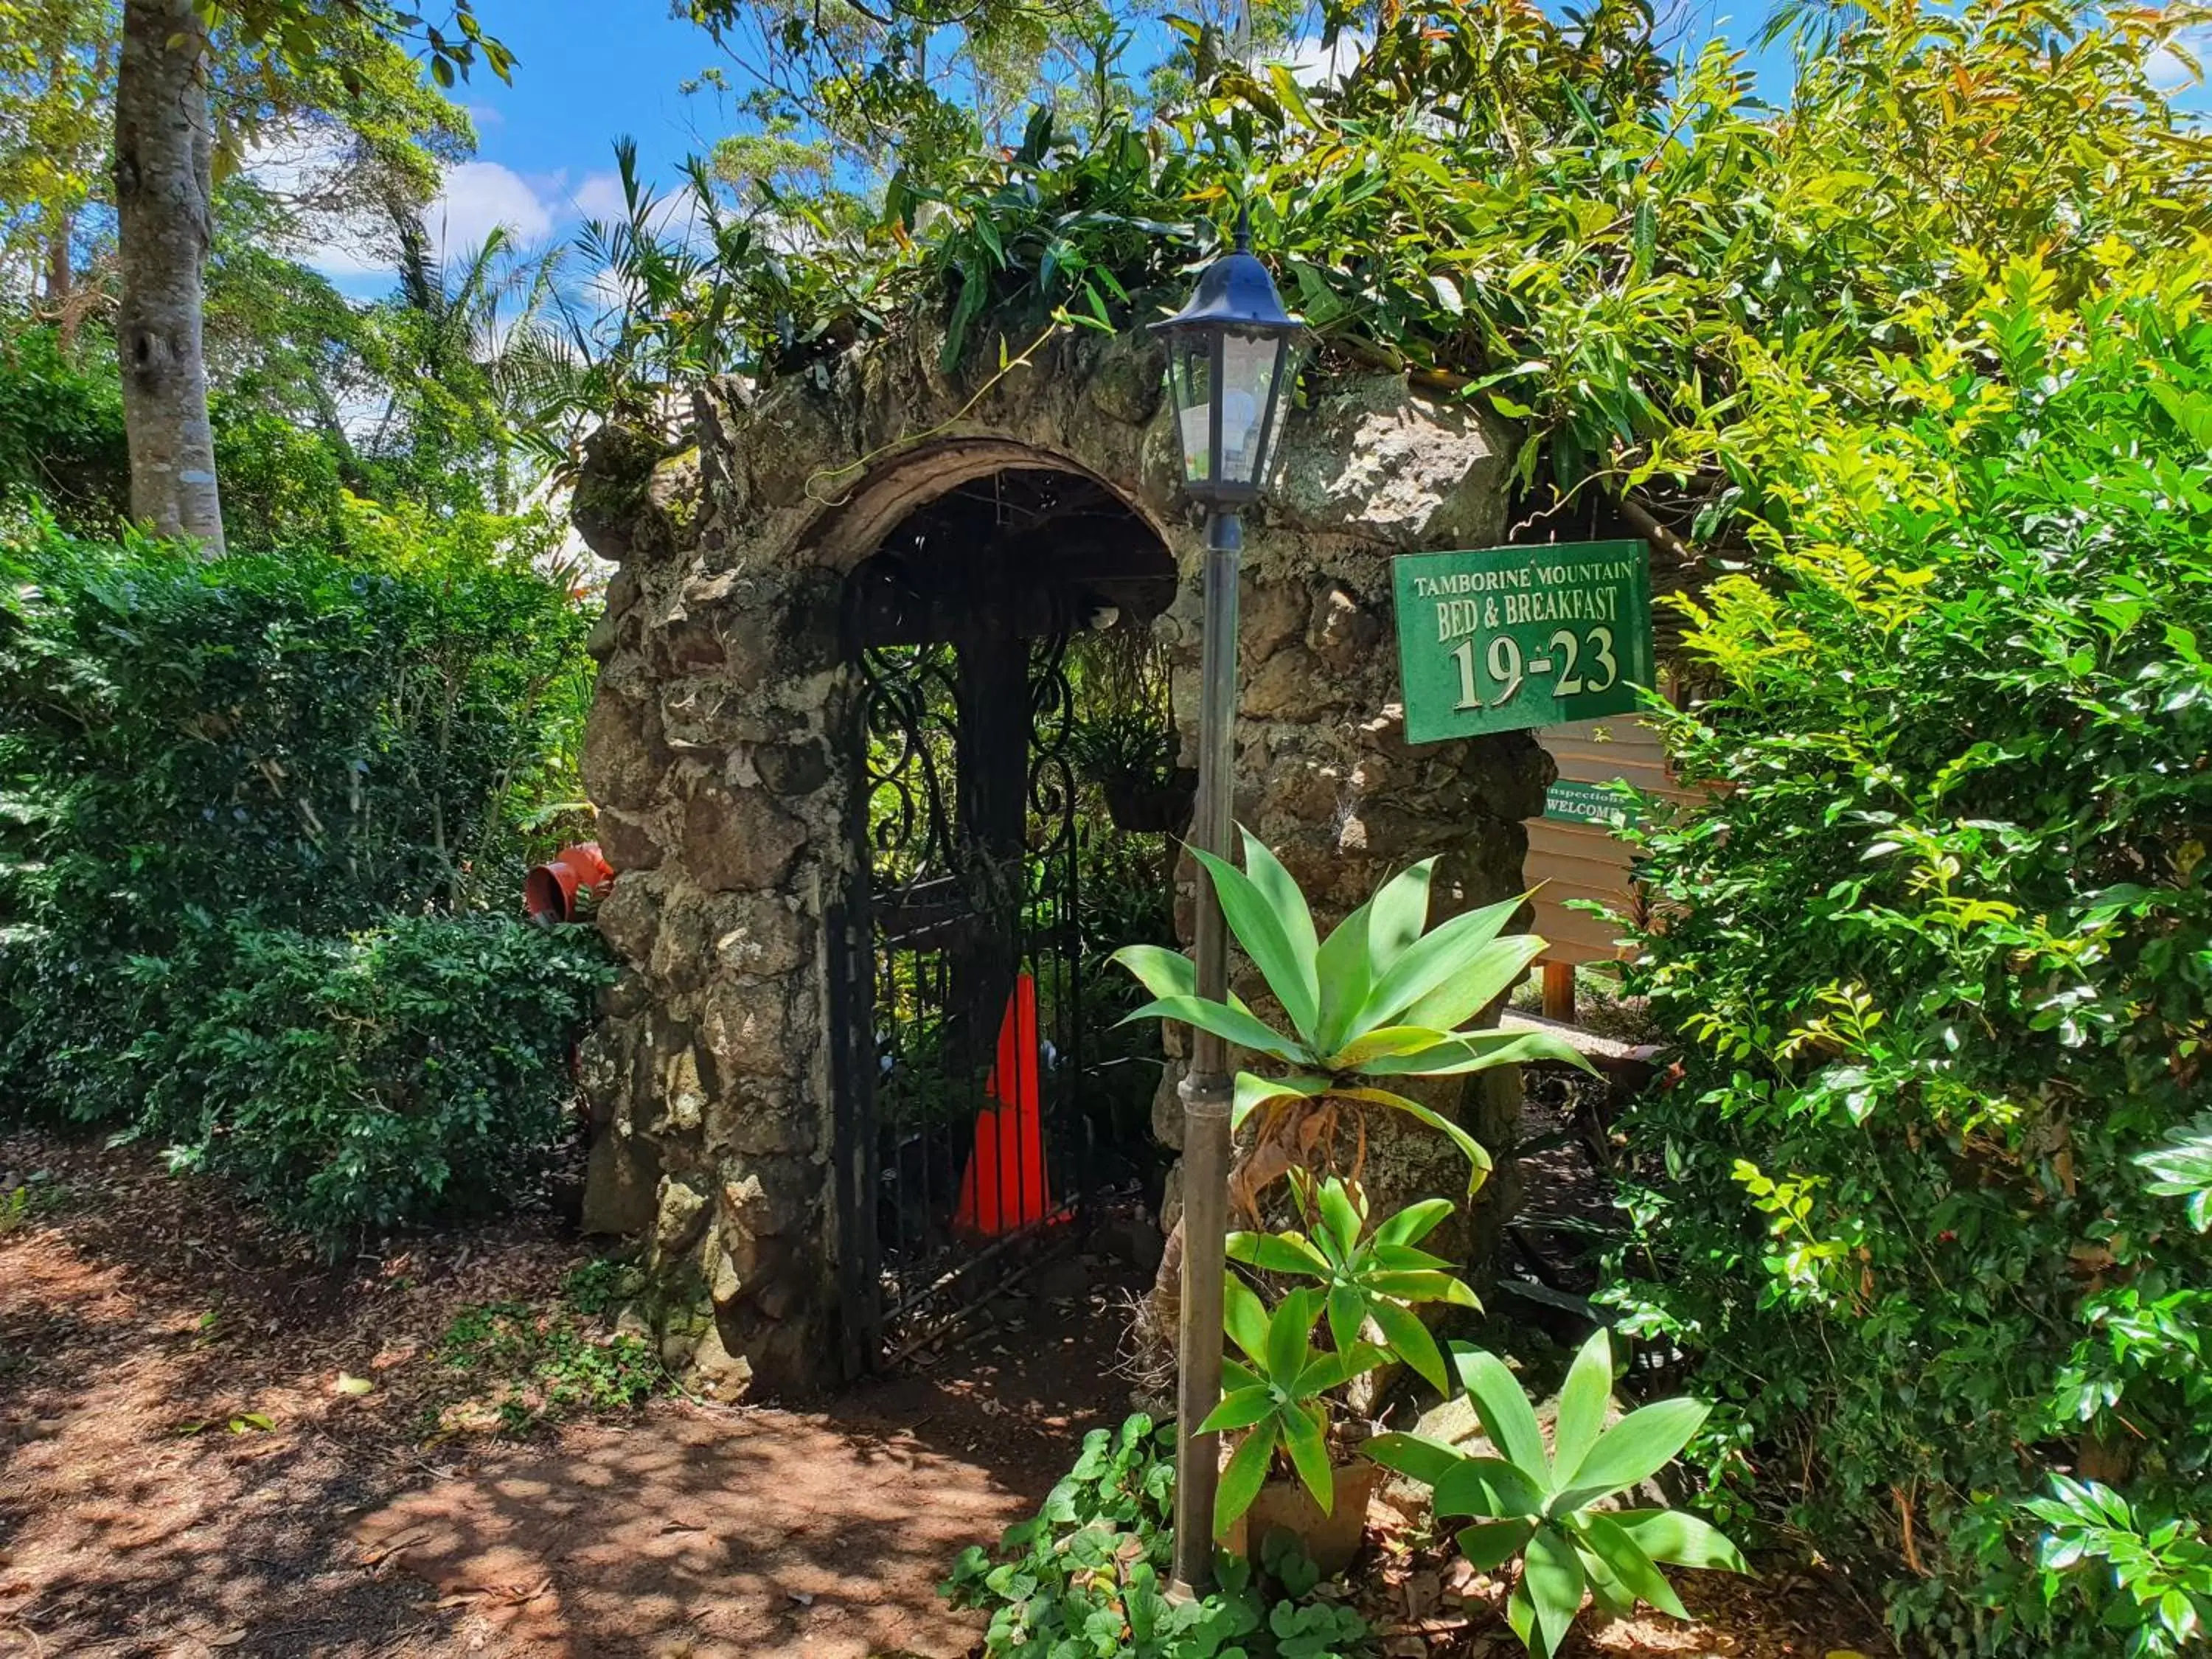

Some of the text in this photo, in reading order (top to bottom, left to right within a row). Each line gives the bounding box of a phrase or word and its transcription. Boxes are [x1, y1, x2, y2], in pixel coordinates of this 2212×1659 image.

[1414, 560, 1634, 597] TAMBORINE MOUNTAIN
[1437, 587, 1618, 642] BED & BREAKFAST
[1450, 625, 1618, 711] 19-23
